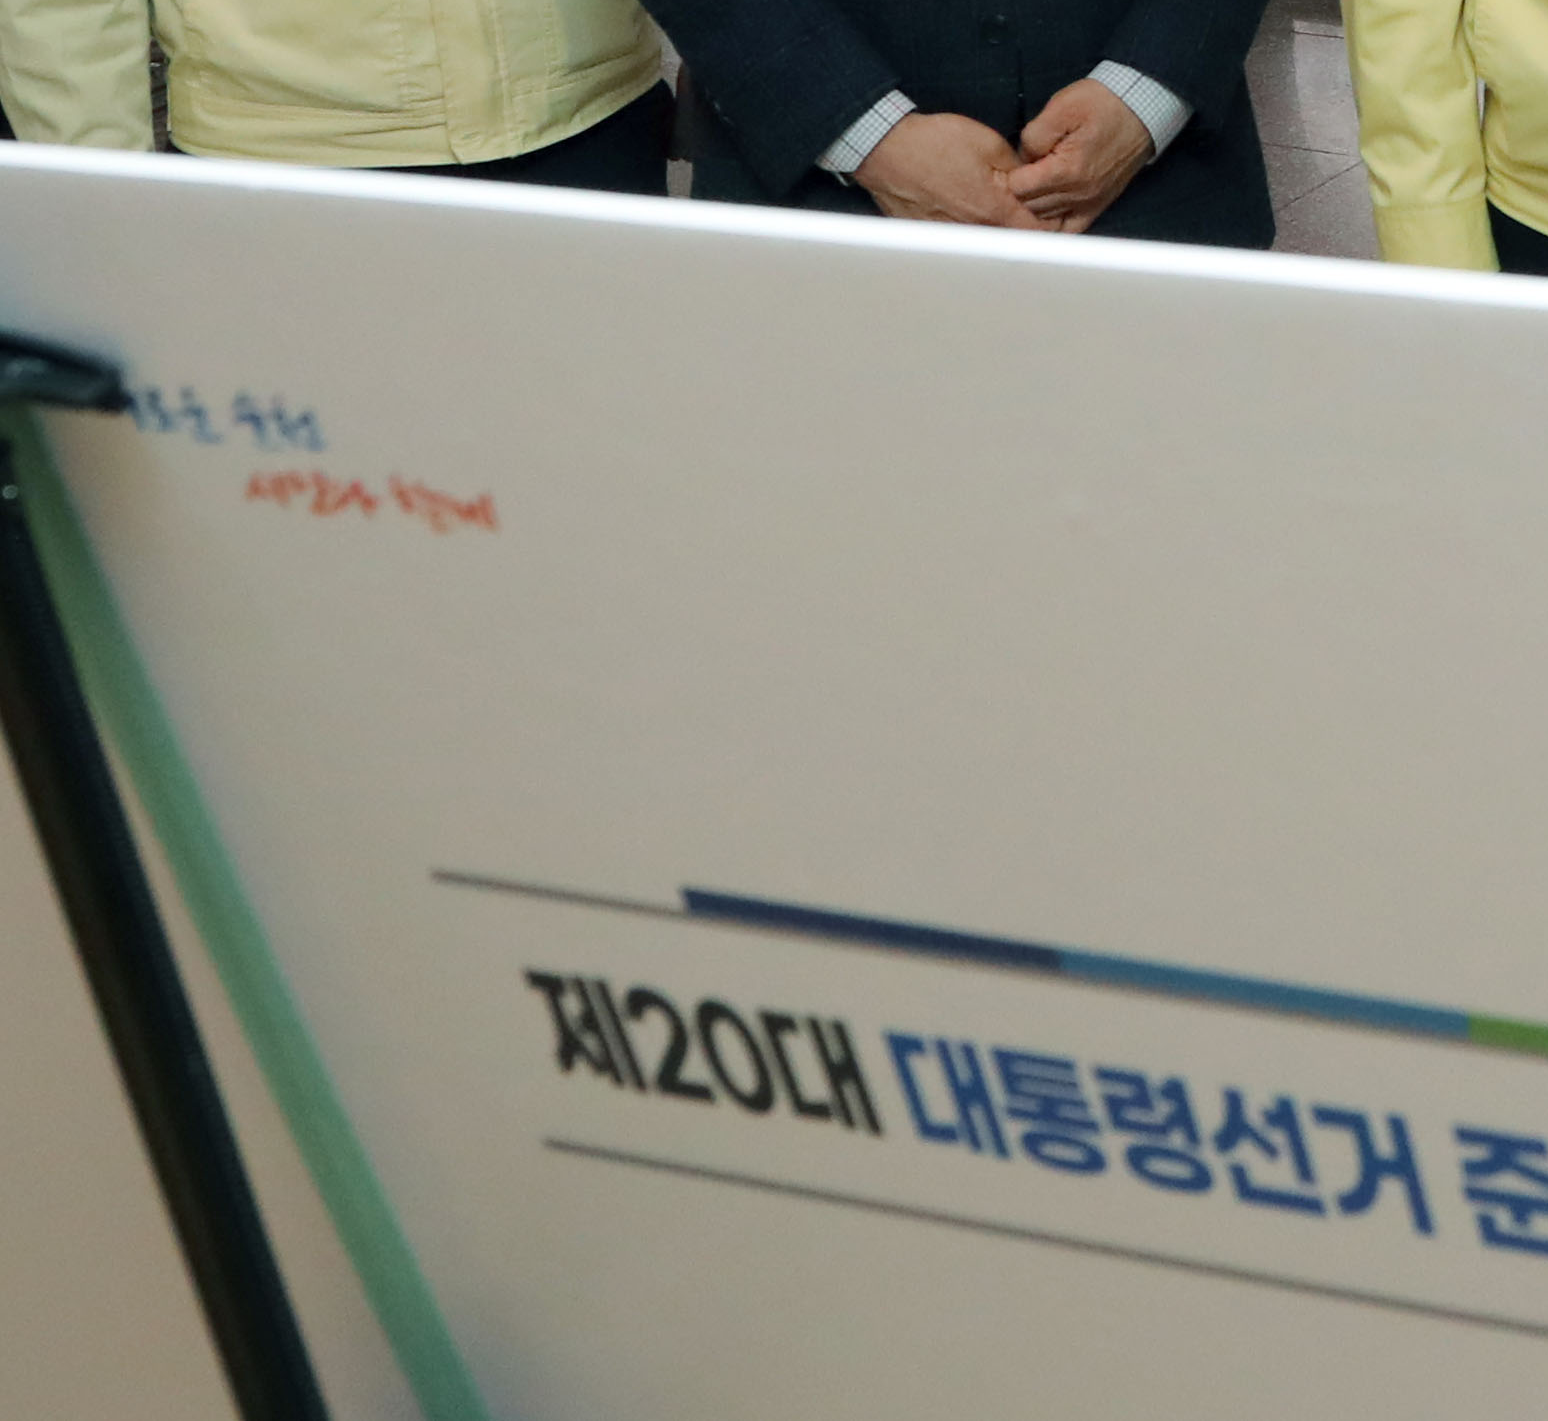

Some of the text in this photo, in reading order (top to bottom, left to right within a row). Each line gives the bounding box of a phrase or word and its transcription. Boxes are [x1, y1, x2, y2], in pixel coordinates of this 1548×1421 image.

[127, 386, 225, 446] 로운
[525, 971, 883, 1137] 제20대
[882, 1028, 1437, 1237] 대통령선거
